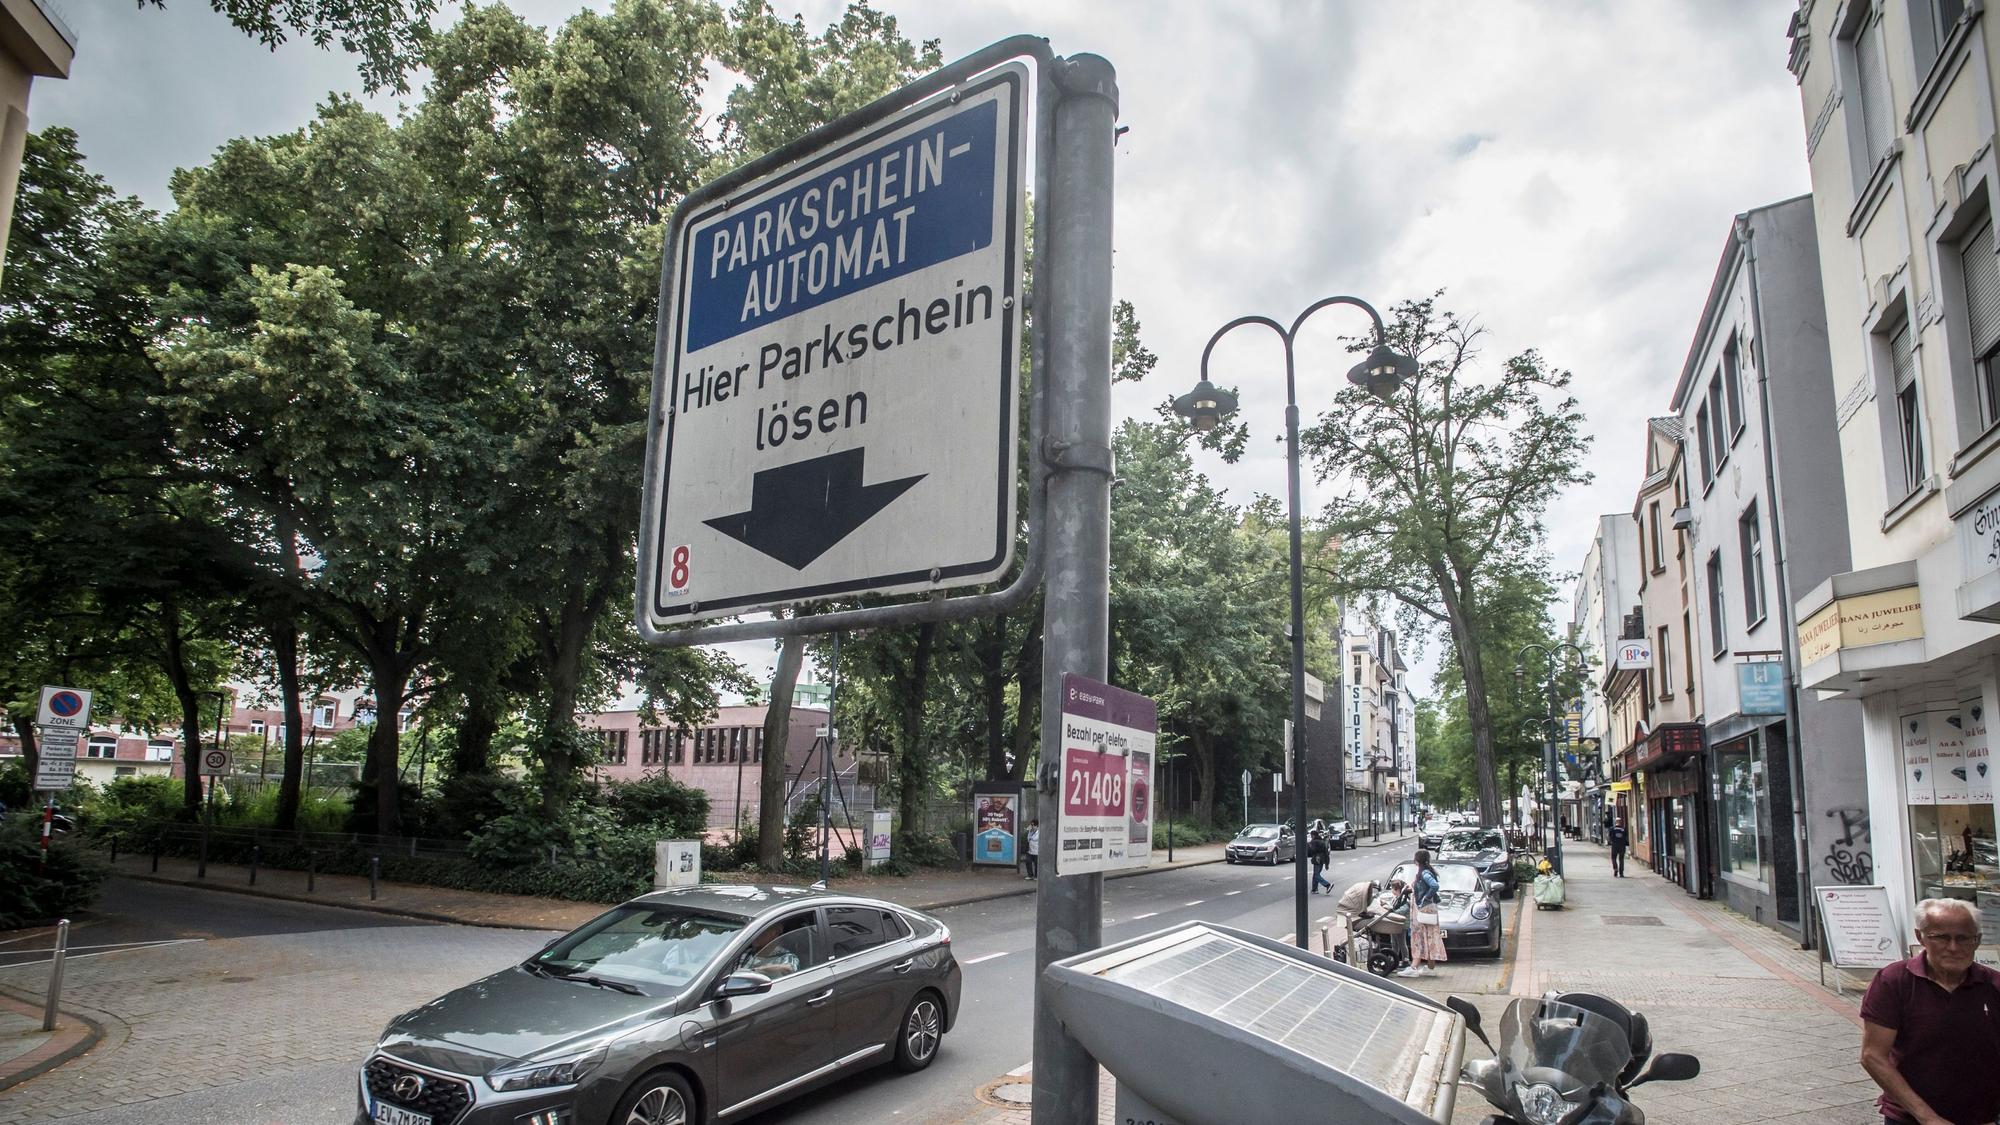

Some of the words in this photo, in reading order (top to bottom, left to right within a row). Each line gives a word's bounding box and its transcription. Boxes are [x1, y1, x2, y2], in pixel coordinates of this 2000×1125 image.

[711, 131, 971, 279] PARKSCHEIN-
[740, 206, 916, 323] AUTOMAT
[683, 360, 750, 413] Hier
[758, 279, 993, 389] Parkschein
[756, 389, 867, 451] lösen
[671, 545, 690, 589] 8
[1840, 613, 1869, 624] RANA
[1871, 602, 1921, 619] JUWELIER
[49, 717, 76, 726] ZONE
[1067, 723, 1092, 742] Bezahl
[1092, 731, 1104, 746] per
[1105, 731, 1128, 747] Telefon
[1353, 687, 1361, 768] STOFFE
[210, 756, 222, 764] 30
[1070, 769, 1121, 807] 21408
[376, 1103, 393, 1123] LEV
